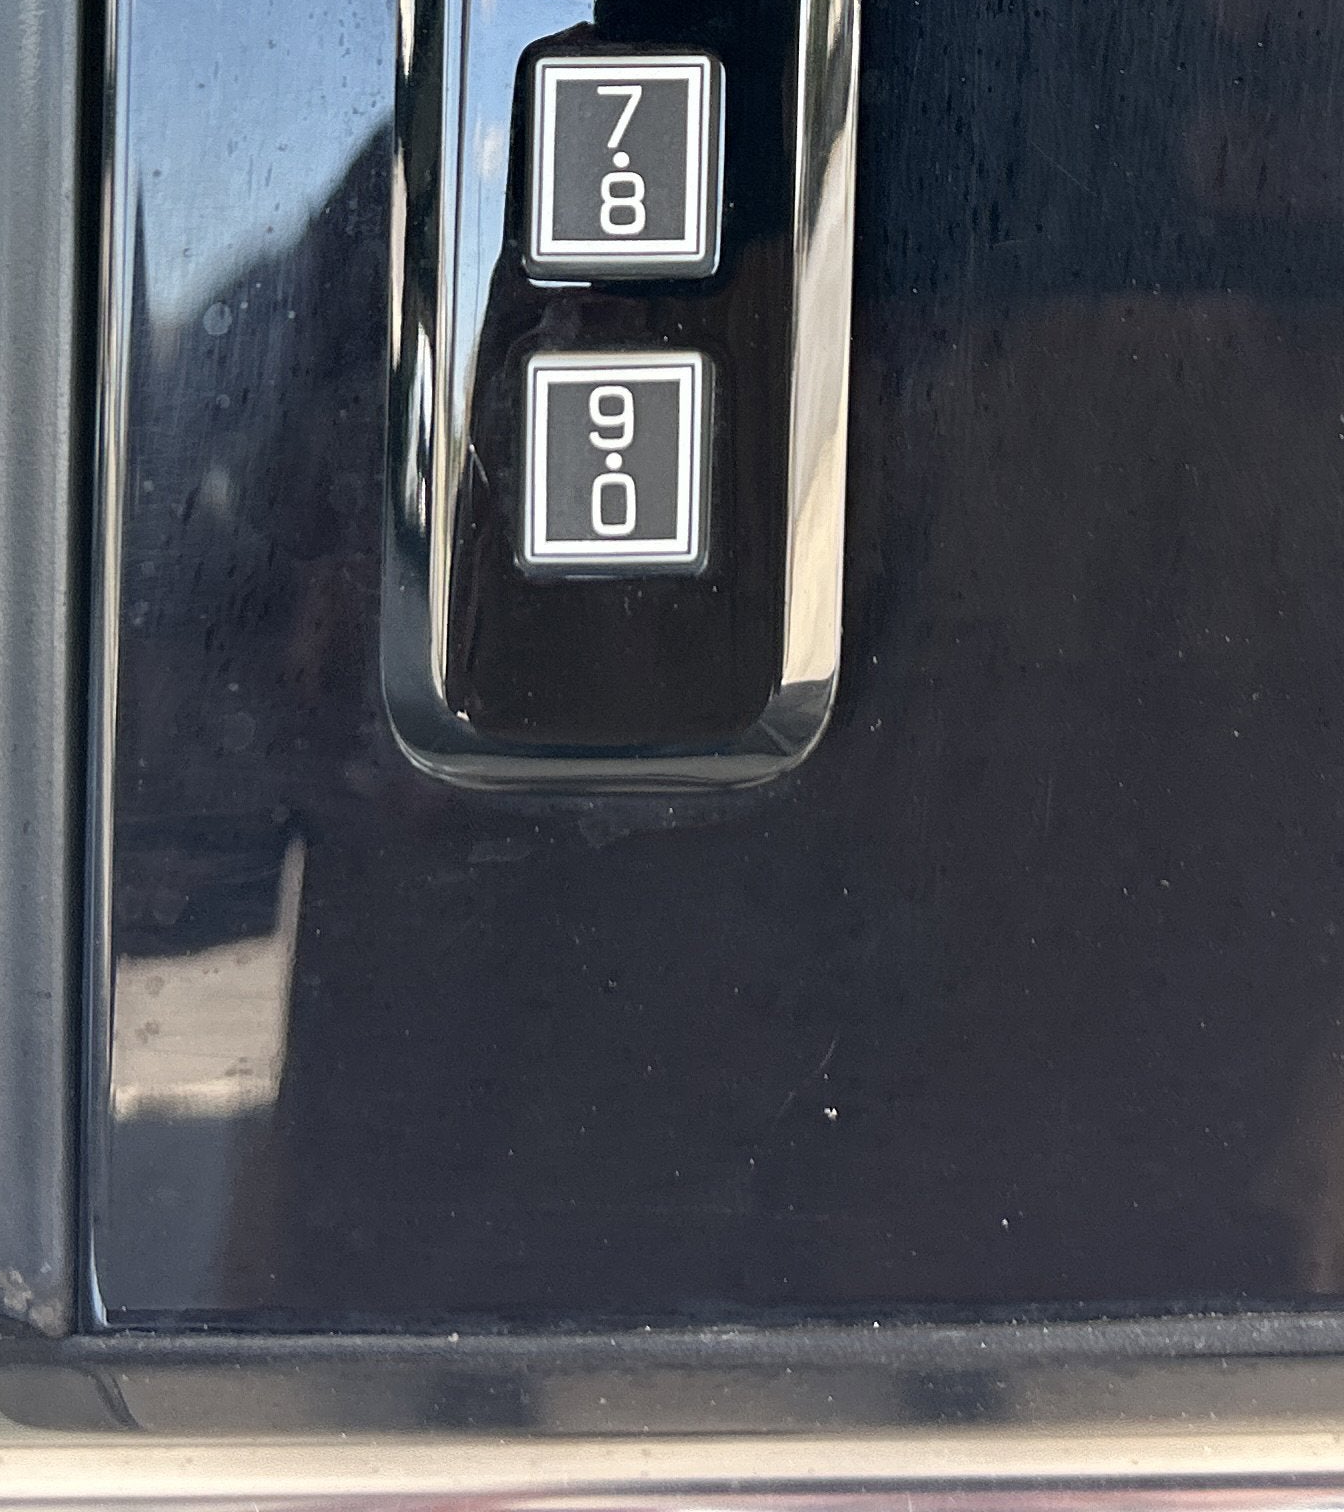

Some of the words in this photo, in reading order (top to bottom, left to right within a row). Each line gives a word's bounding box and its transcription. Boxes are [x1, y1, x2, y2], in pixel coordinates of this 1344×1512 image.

[596, 85, 643, 149] 7
[599, 171, 646, 236] 8
[588, 385, 635, 451] 9
[591, 472, 637, 537] 0
